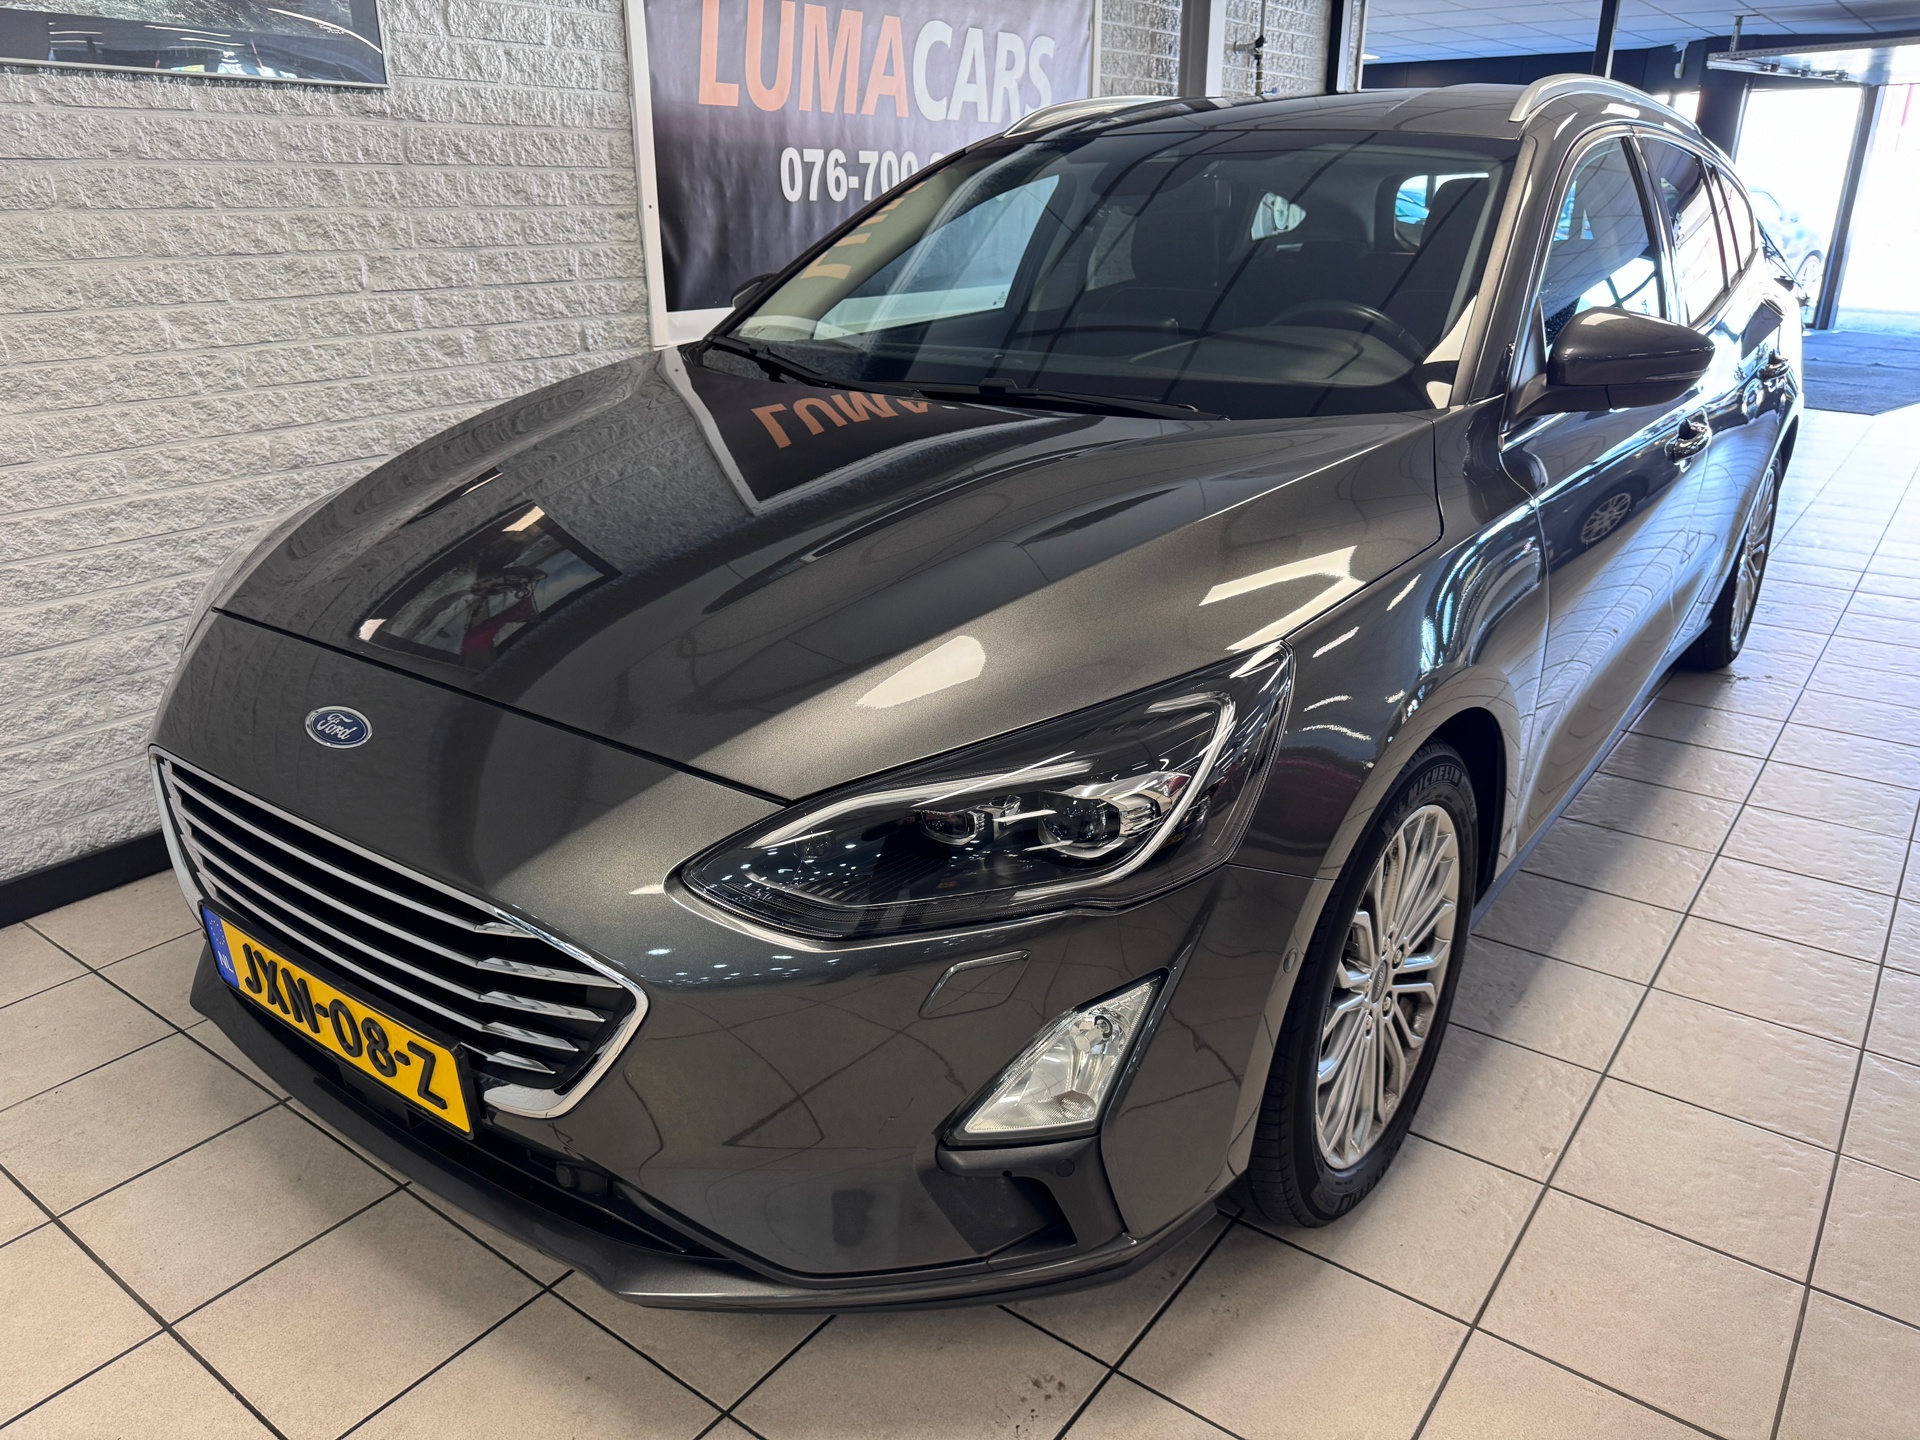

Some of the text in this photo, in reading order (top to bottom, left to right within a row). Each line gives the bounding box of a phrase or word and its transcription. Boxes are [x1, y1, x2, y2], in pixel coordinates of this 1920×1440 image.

[698, 0, 1055, 123] LUMACARS
[316, 712, 358, 740] Ford
[1407, 765, 1461, 805] MICHELIN
[217, 950, 235, 974] NL
[242, 942, 447, 1110] JXN-08-Z
